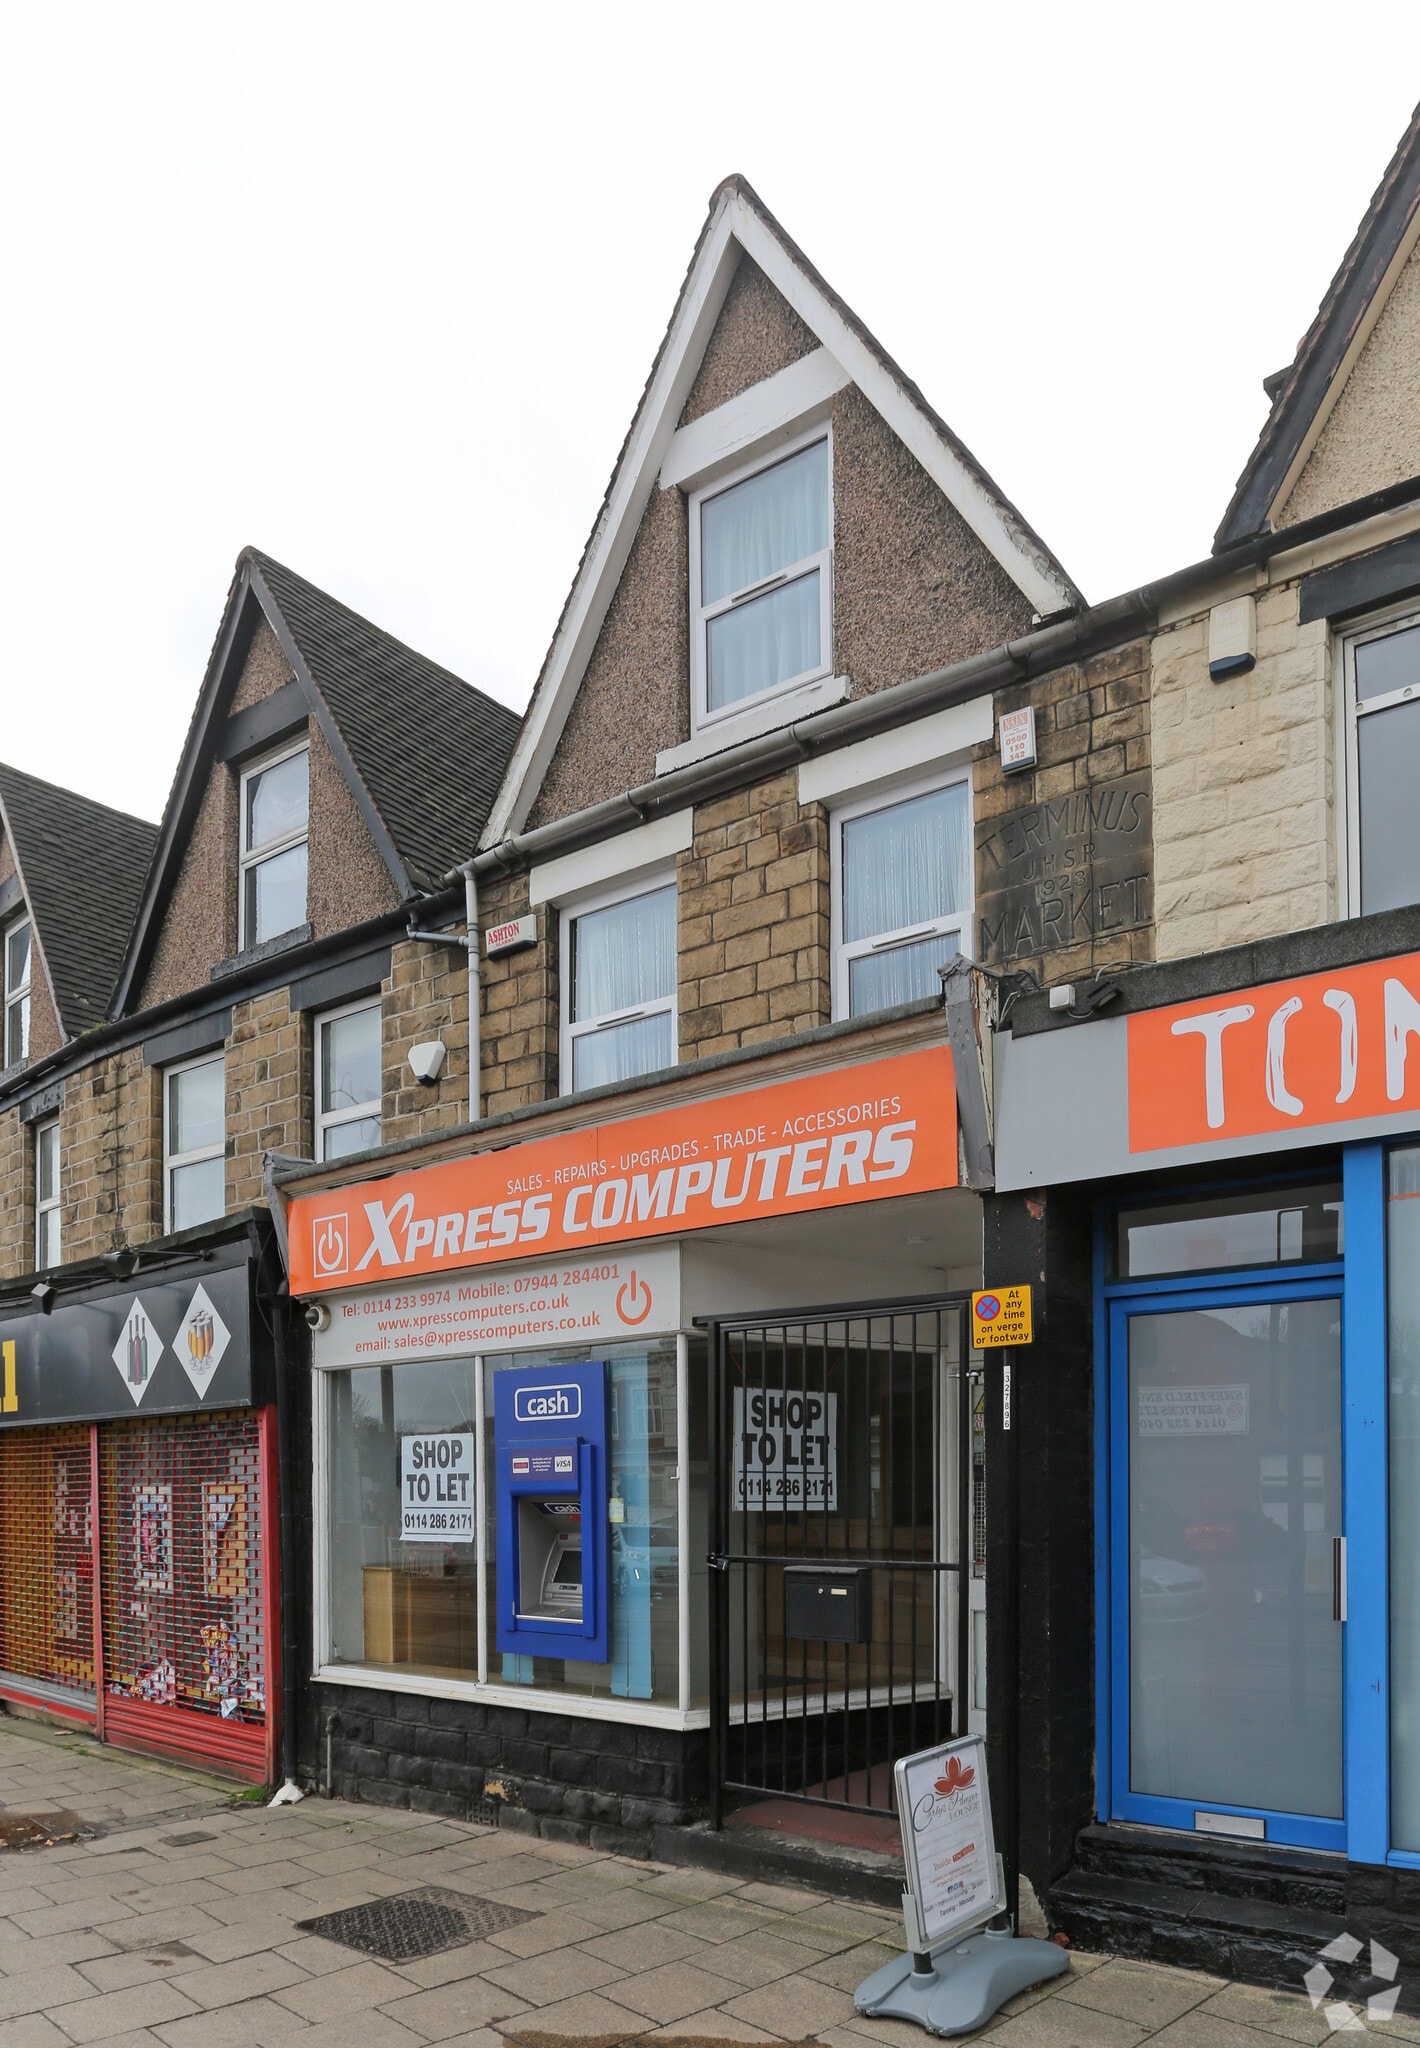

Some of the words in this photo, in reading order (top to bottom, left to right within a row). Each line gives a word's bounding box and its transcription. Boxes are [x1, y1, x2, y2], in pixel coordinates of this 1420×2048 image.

[1005, 732, 1027, 746] 0500
[976, 791, 1149, 870] TERMINUS
[1035, 870, 1087, 900] 1923
[488, 922, 519, 945] ASHTON
[506, 1174, 543, 1195] SALES
[554, 1161, 607, 1184] REPAIRS
[619, 1140, 698, 1171] UPGRADES
[713, 1127, 766, 1152] TRADE
[782, 1096, 901, 1135] ACCESSORIES
[354, 1191, 552, 1271] XPRESS
[562, 1119, 917, 1235] COMPUTERS
[341, 1304, 360, 1318] Tel:
[363, 1299, 391, 1315] 0114
[395, 1296, 416, 1311] 233
[420, 1290, 451, 1308] 9974
[458, 1282, 510, 1302] Mobile:
[514, 1272, 558, 1293] 07944
[562, 1264, 620, 1287] 284401
[1008, 1290, 1020, 1299] At
[377, 1293, 569, 1332] www.xpresscomputers.co.uk
[1003, 1310, 1025, 1320] time
[1005, 1301, 1023, 1309] any
[355, 1335, 391, 1353] email:
[393, 1310, 601, 1349] sales@xpresscomputers.co.uk
[976, 1336, 986, 1345] or
[989, 1332, 1029, 1343] footway
[981, 1324, 993, 1333] on
[997, 1321, 1023, 1332] verge
[527, 1390, 569, 1415] cash
[751, 1395, 822, 1429] SHOP
[412, 1439, 463, 1469] SHOP
[741, 1433, 776, 1466] TO
[784, 1434, 830, 1466] LET
[556, 1460, 571, 1468] VISA
[406, 1473, 430, 1502] TO
[436, 1473, 469, 1502] LET
[738, 1478, 771, 1496] 0114
[803, 1479, 833, 1497] 2171
[555, 1504, 580, 1513] cash
[404, 1513, 427, 1528] 0114
[430, 1513, 447, 1529] 286
[450, 1513, 472, 1529] 2171
[949, 1801, 981, 1820] LOUNGE
